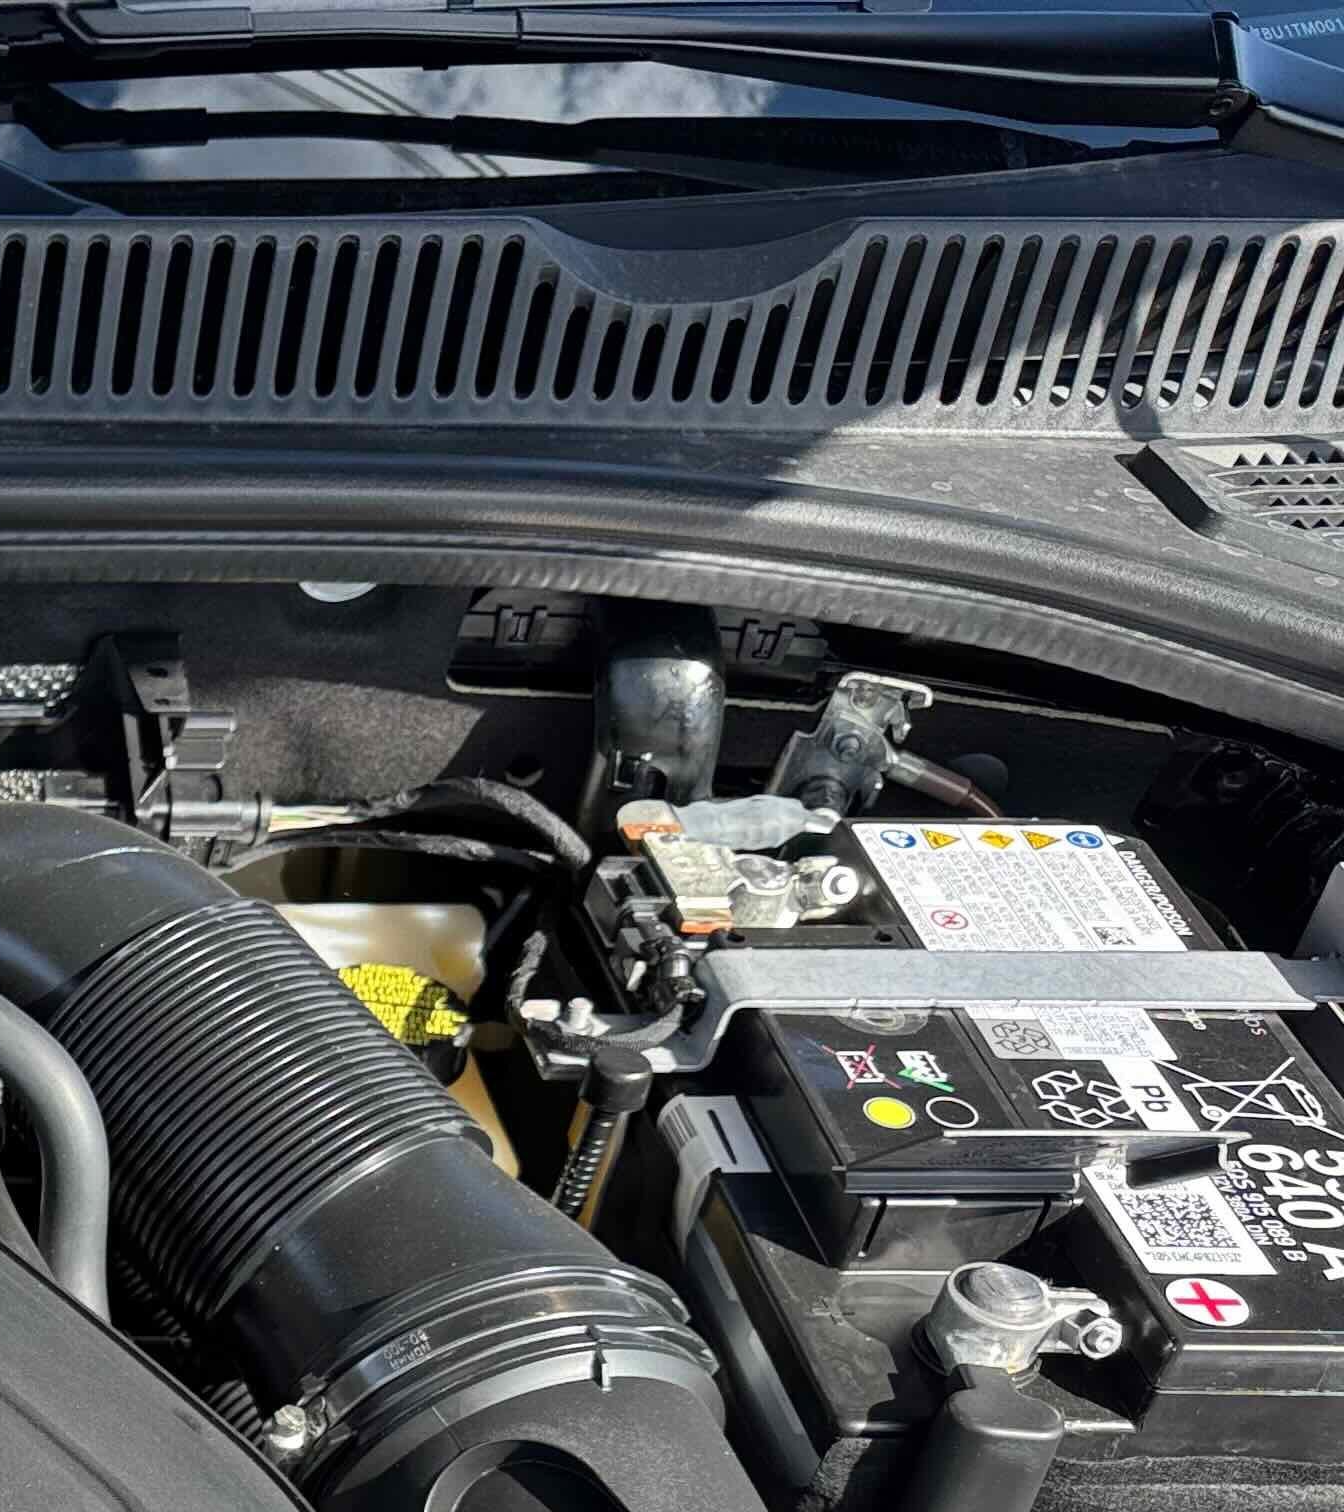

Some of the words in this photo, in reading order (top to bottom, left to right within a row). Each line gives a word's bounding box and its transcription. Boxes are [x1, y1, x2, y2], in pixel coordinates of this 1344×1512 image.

[1118, 849, 1193, 937] DANGER/POISON
[1131, 1085, 1173, 1113] Pb
[1238, 1144, 1344, 1228] 640
[1242, 1192, 1277, 1217] 915
[1261, 1219, 1297, 1246] 089
[1282, 1249, 1308, 1262] B
[1245, 1224, 1273, 1246] DIN
